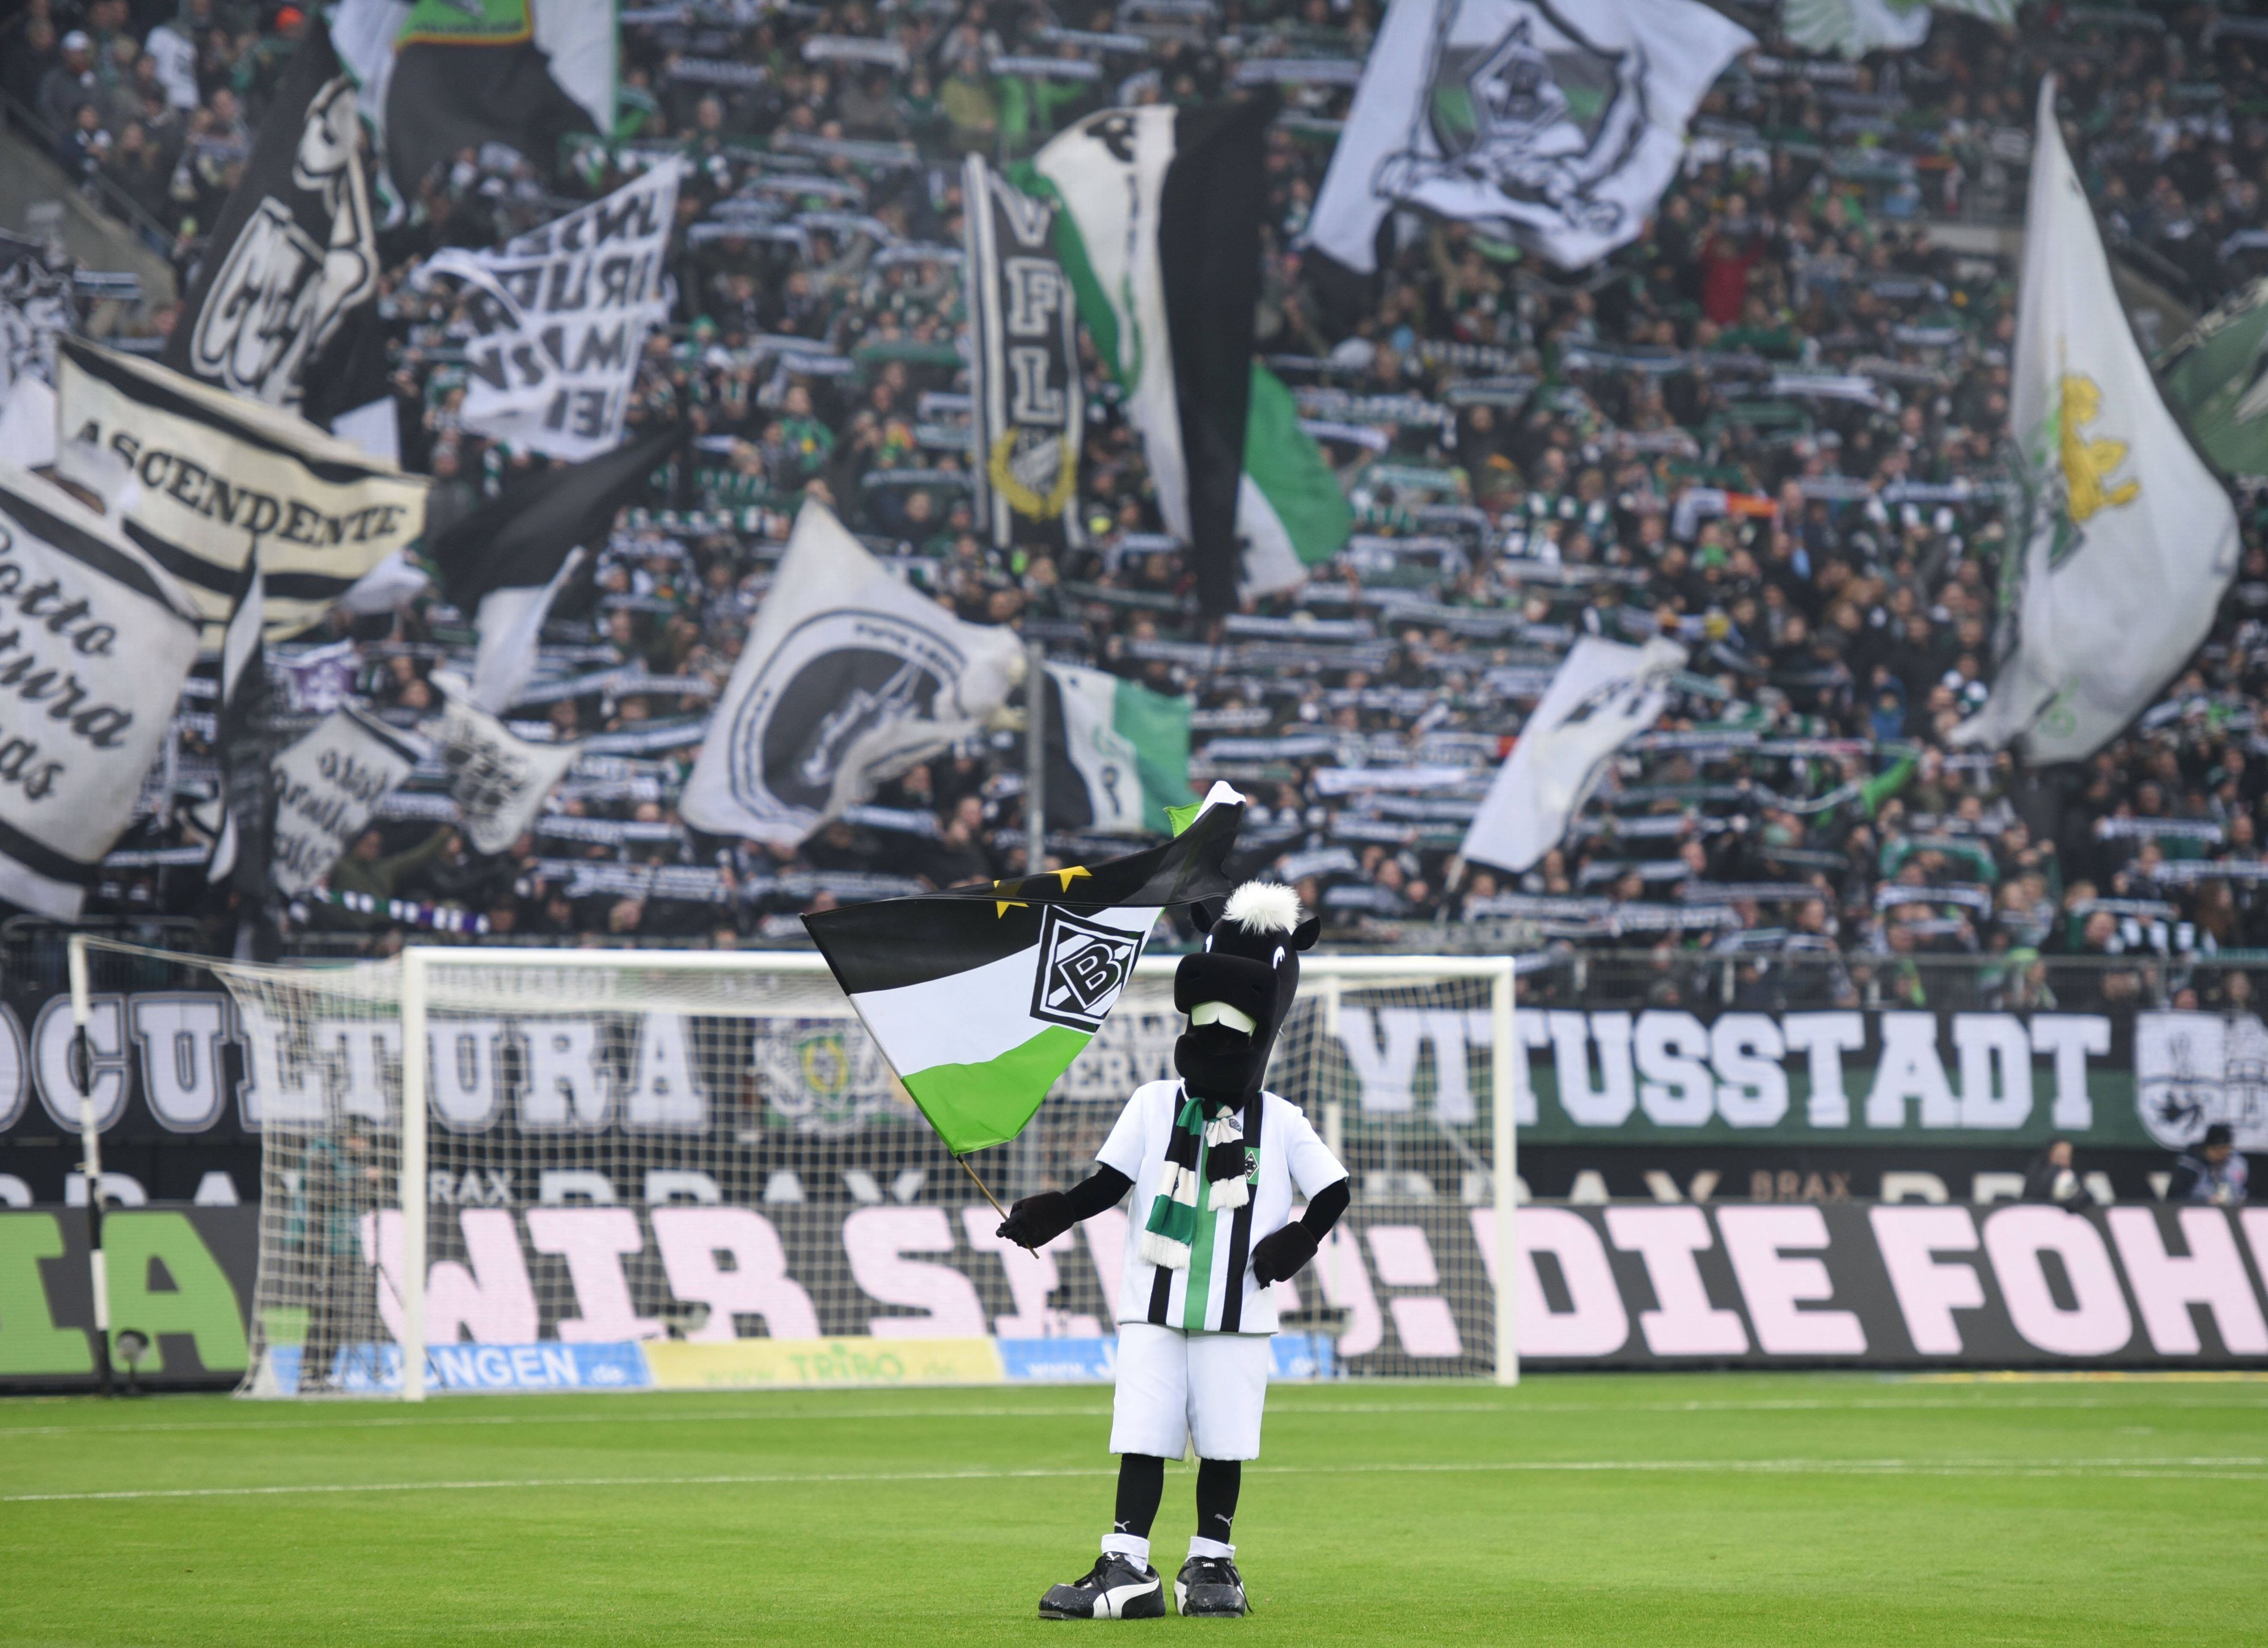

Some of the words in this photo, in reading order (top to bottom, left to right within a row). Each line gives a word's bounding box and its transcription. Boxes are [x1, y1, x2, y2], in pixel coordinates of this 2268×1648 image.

[75, 419, 407, 547] ASCENDENTE
[0, 524, 117, 657] otto
[1339, 1007, 2111, 1131] VITUSSTADT
[429, 1168, 517, 1204] RAX
[1750, 1170, 1852, 1202] BRAX
[361, 1208, 820, 1345] WIR
[1470, 1206, 1869, 1357] DIE
[1868, 1205, 2268, 1357] FOH
